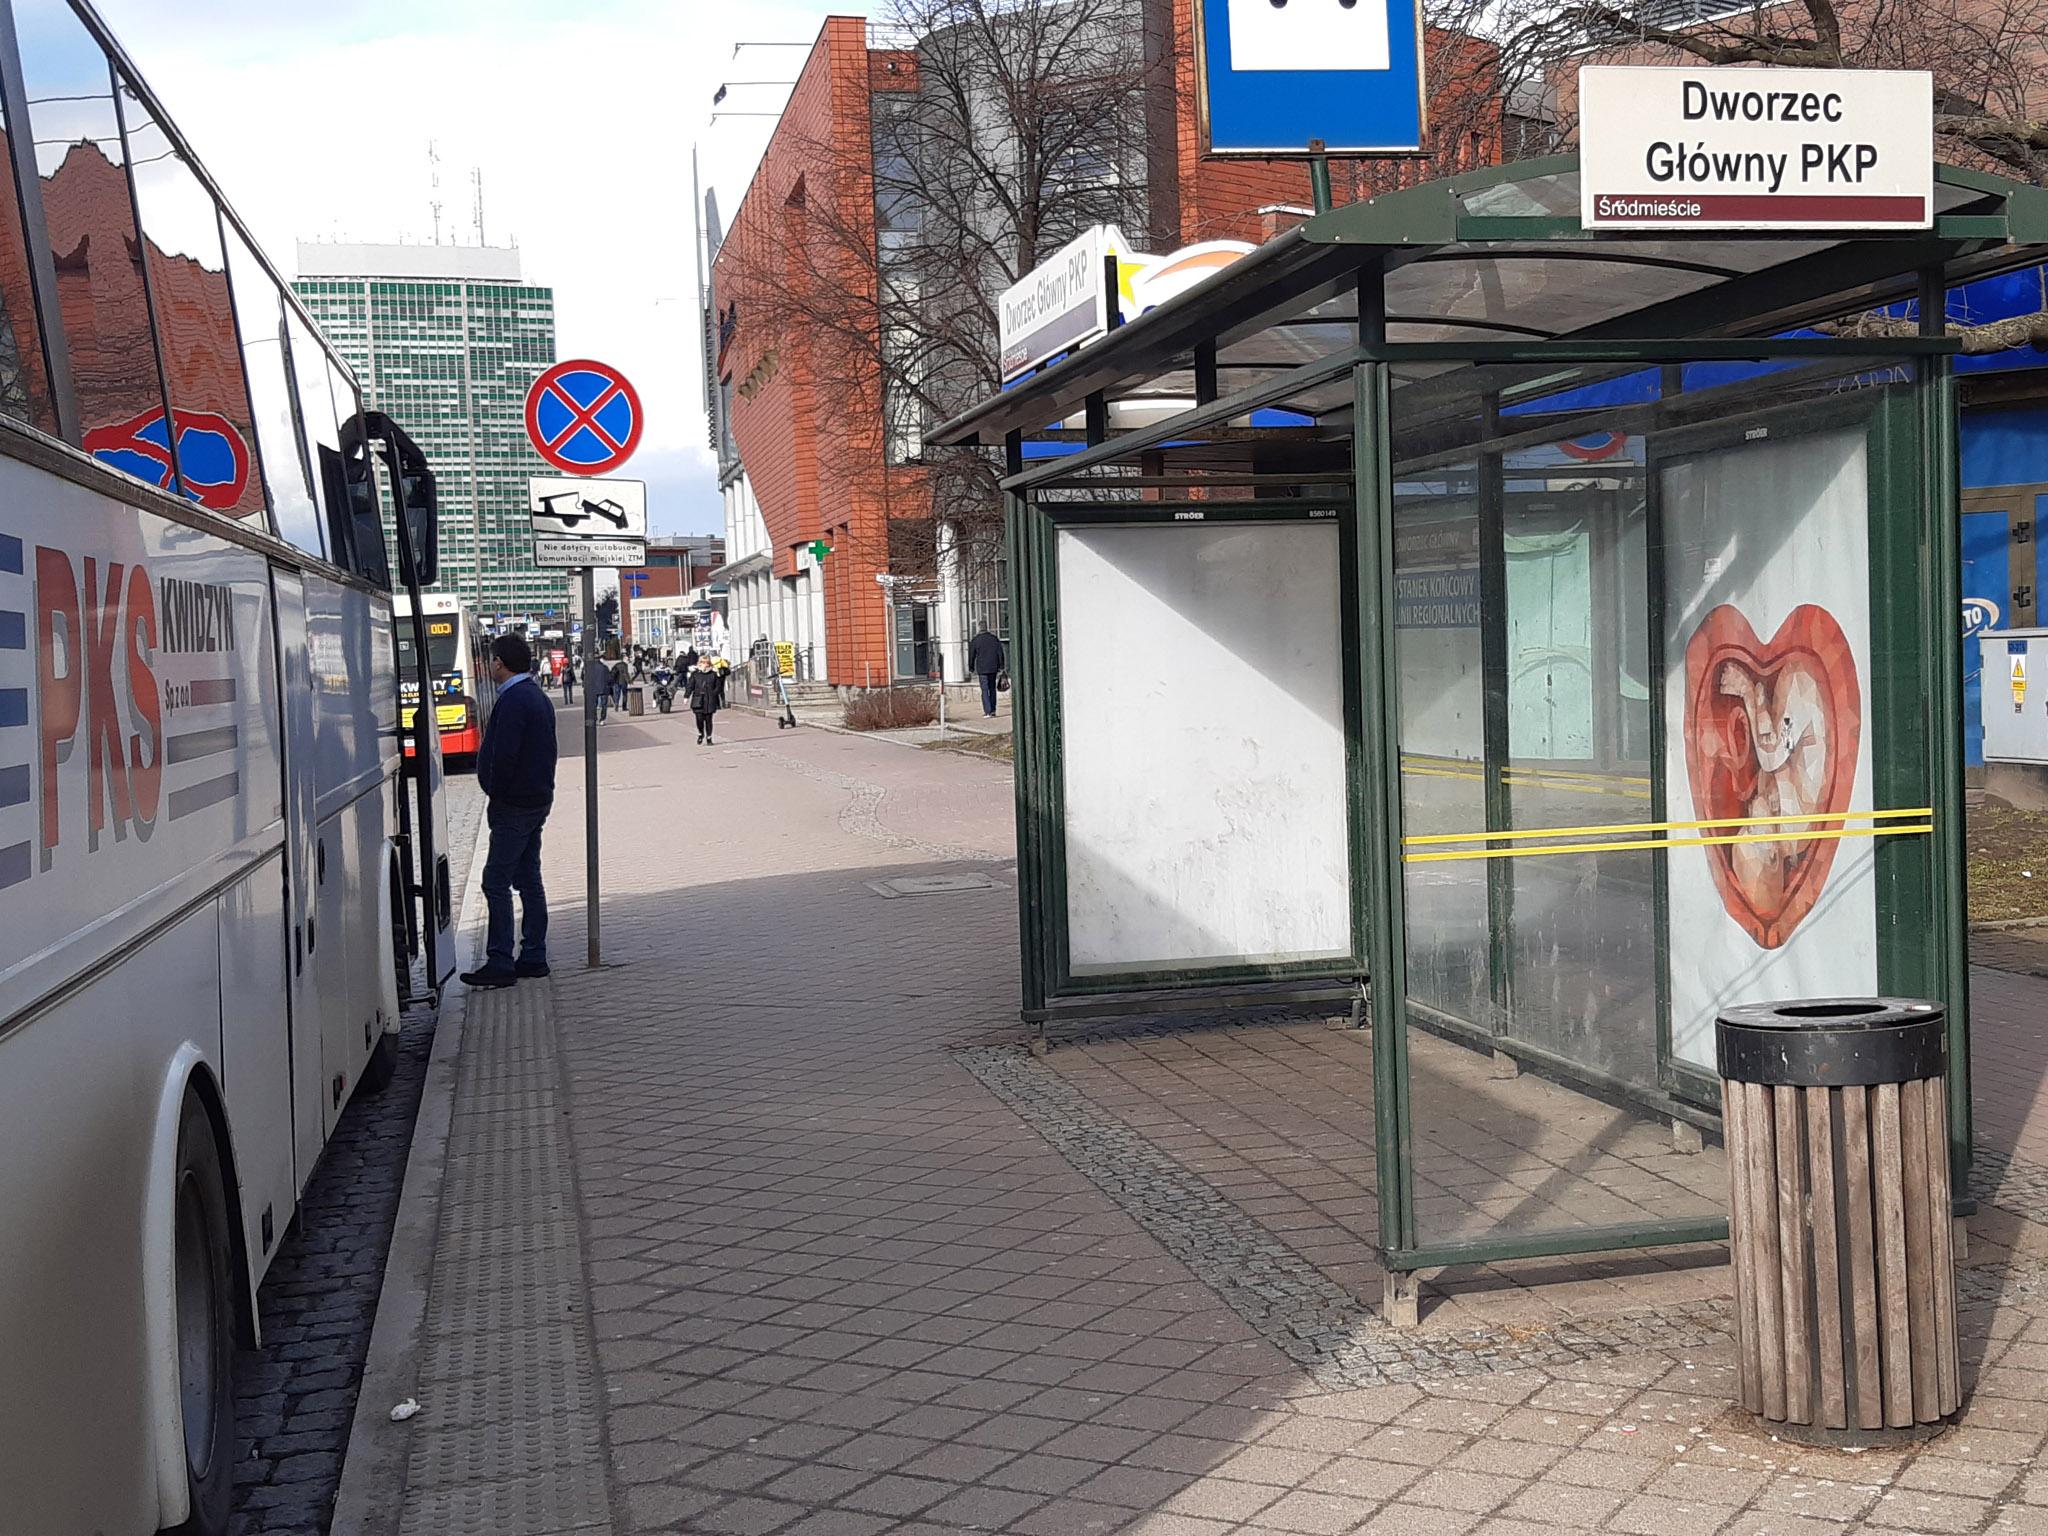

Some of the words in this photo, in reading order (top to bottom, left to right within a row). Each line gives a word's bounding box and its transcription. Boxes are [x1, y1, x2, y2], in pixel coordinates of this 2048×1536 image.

[1683, 80, 1843, 122] Dworzec
[1646, 140, 1788, 193] Główny
[1801, 143, 1878, 183] PKP
[1598, 196, 1702, 217] Śródmieście
[1005, 296, 1037, 336] Dworzec
[1037, 273, 1068, 317] Główny
[1068, 249, 1089, 297] PKP
[1174, 512, 1205, 520] STRÖER
[538, 553, 588, 564] komunikacji
[590, 553, 626, 564] miejskiej
[628, 554, 644, 562] ZTM
[543, 543, 558, 552] Nie
[560, 543, 591, 553] dotyczy
[1430, 574, 1475, 597] KOŃCOWY
[160, 577, 235, 653] KWIDZYN
[1413, 602, 1480, 624] REGIONALNYCH
[33, 545, 162, 866] PKS
